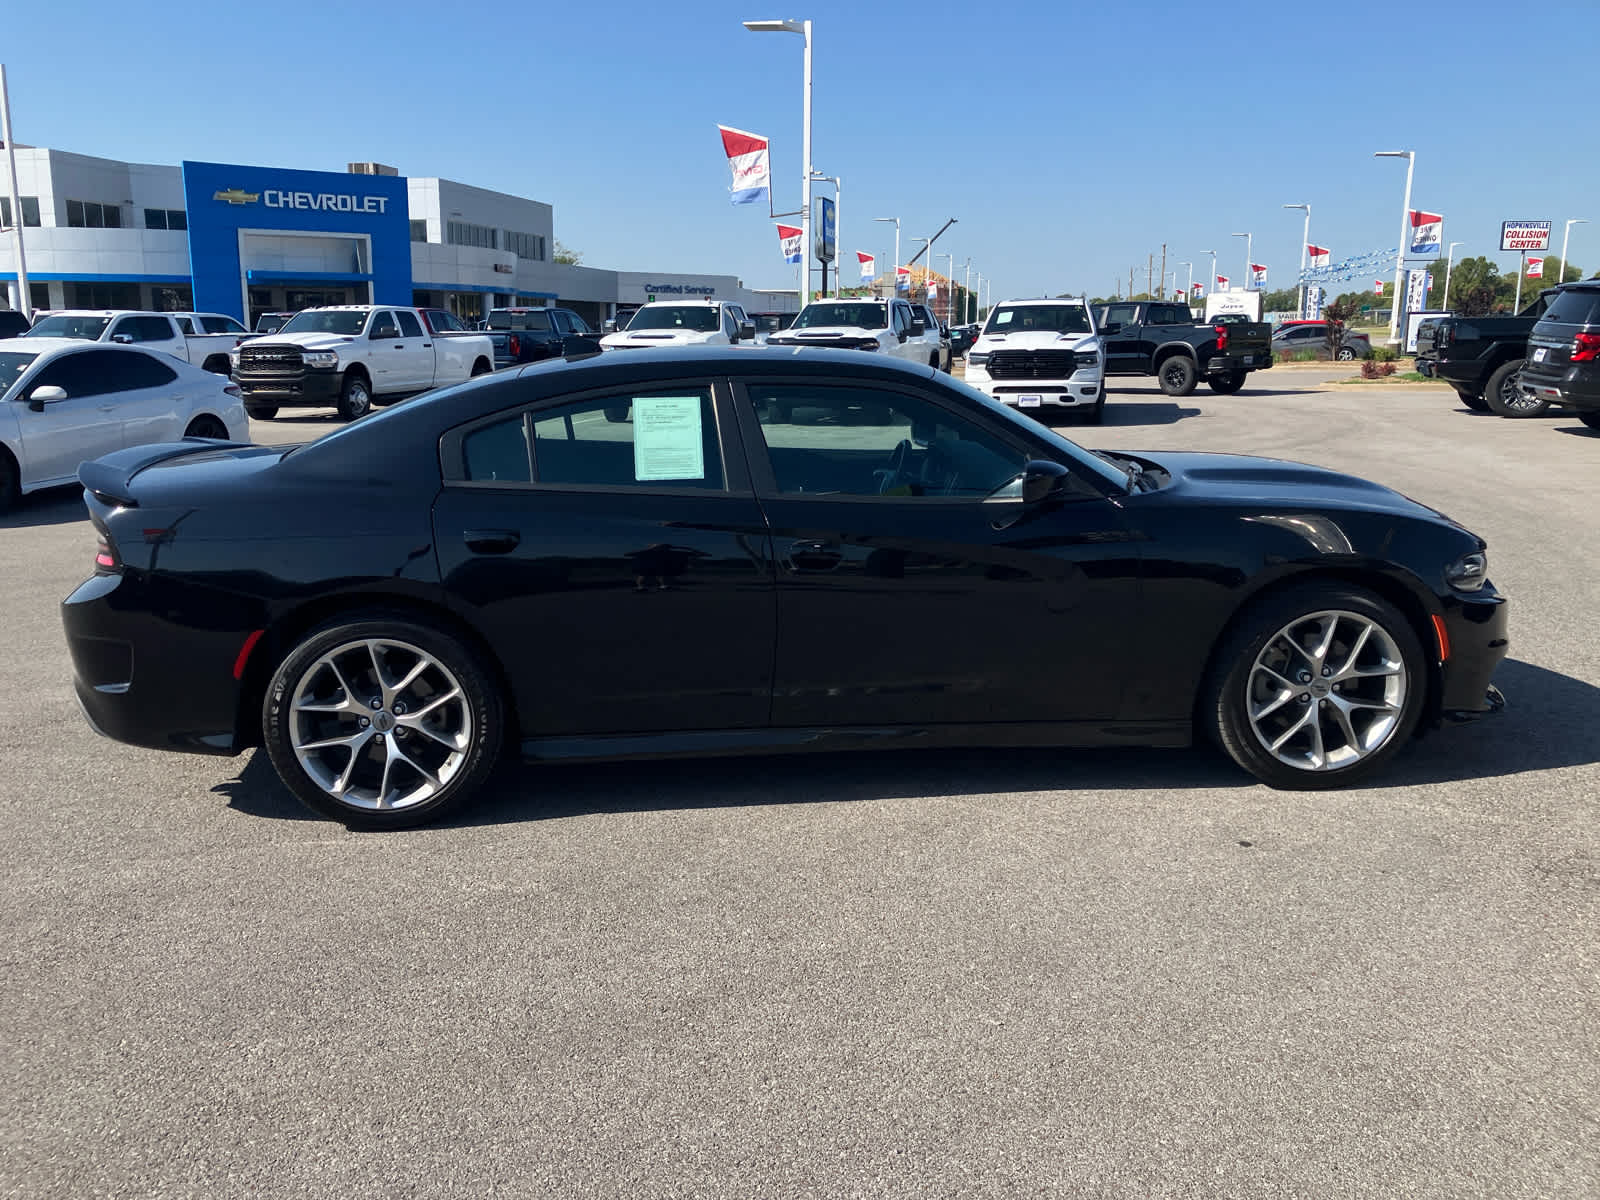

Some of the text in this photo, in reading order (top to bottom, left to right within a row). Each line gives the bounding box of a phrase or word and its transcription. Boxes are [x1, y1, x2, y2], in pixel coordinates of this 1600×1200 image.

[264, 190, 388, 213] CHEVROLET
[1505, 230, 1549, 239] COLLISION
[1510, 240, 1542, 248] CENTER
[644, 284, 715, 295] Certified Service
